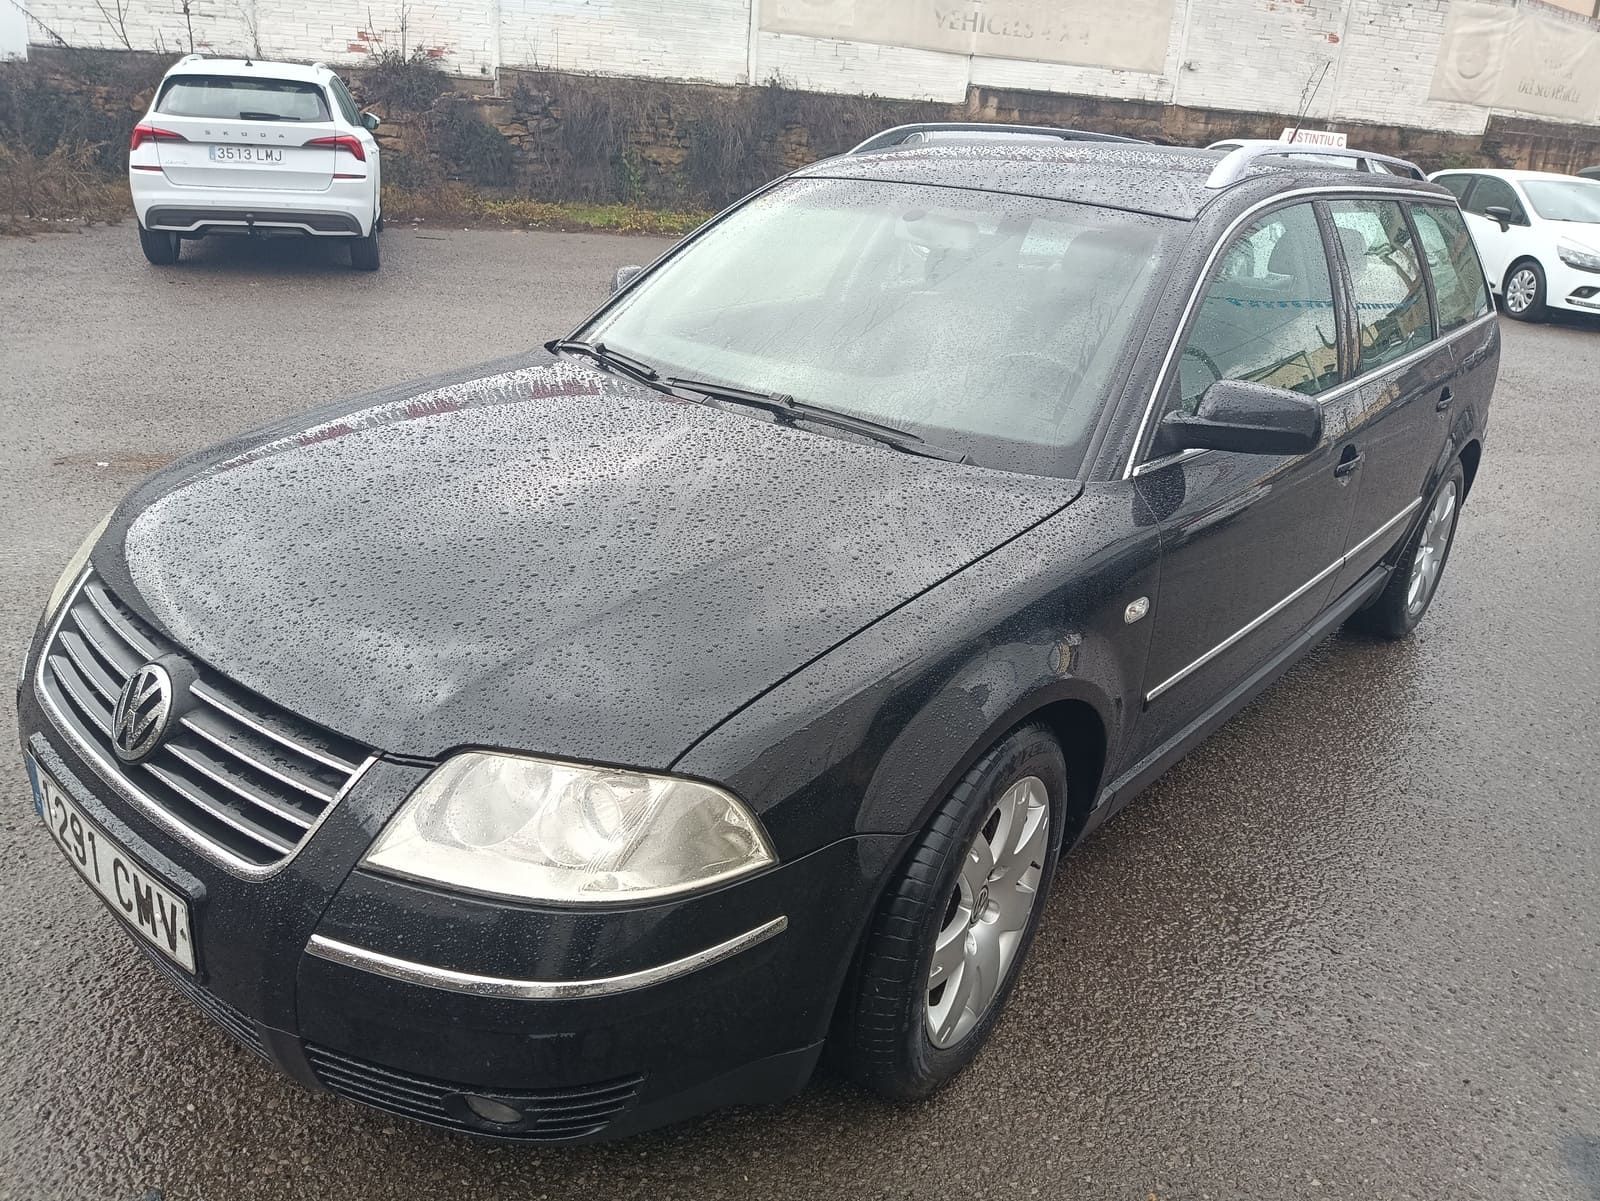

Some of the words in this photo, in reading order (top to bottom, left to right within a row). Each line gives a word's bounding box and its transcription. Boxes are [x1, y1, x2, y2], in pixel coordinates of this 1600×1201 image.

[1337, 136, 1344, 147] C
[217, 147, 252, 160] 3513
[256, 149, 282, 162] LMJ
[42, 779, 101, 884] 1291
[113, 857, 178, 953] CMV
